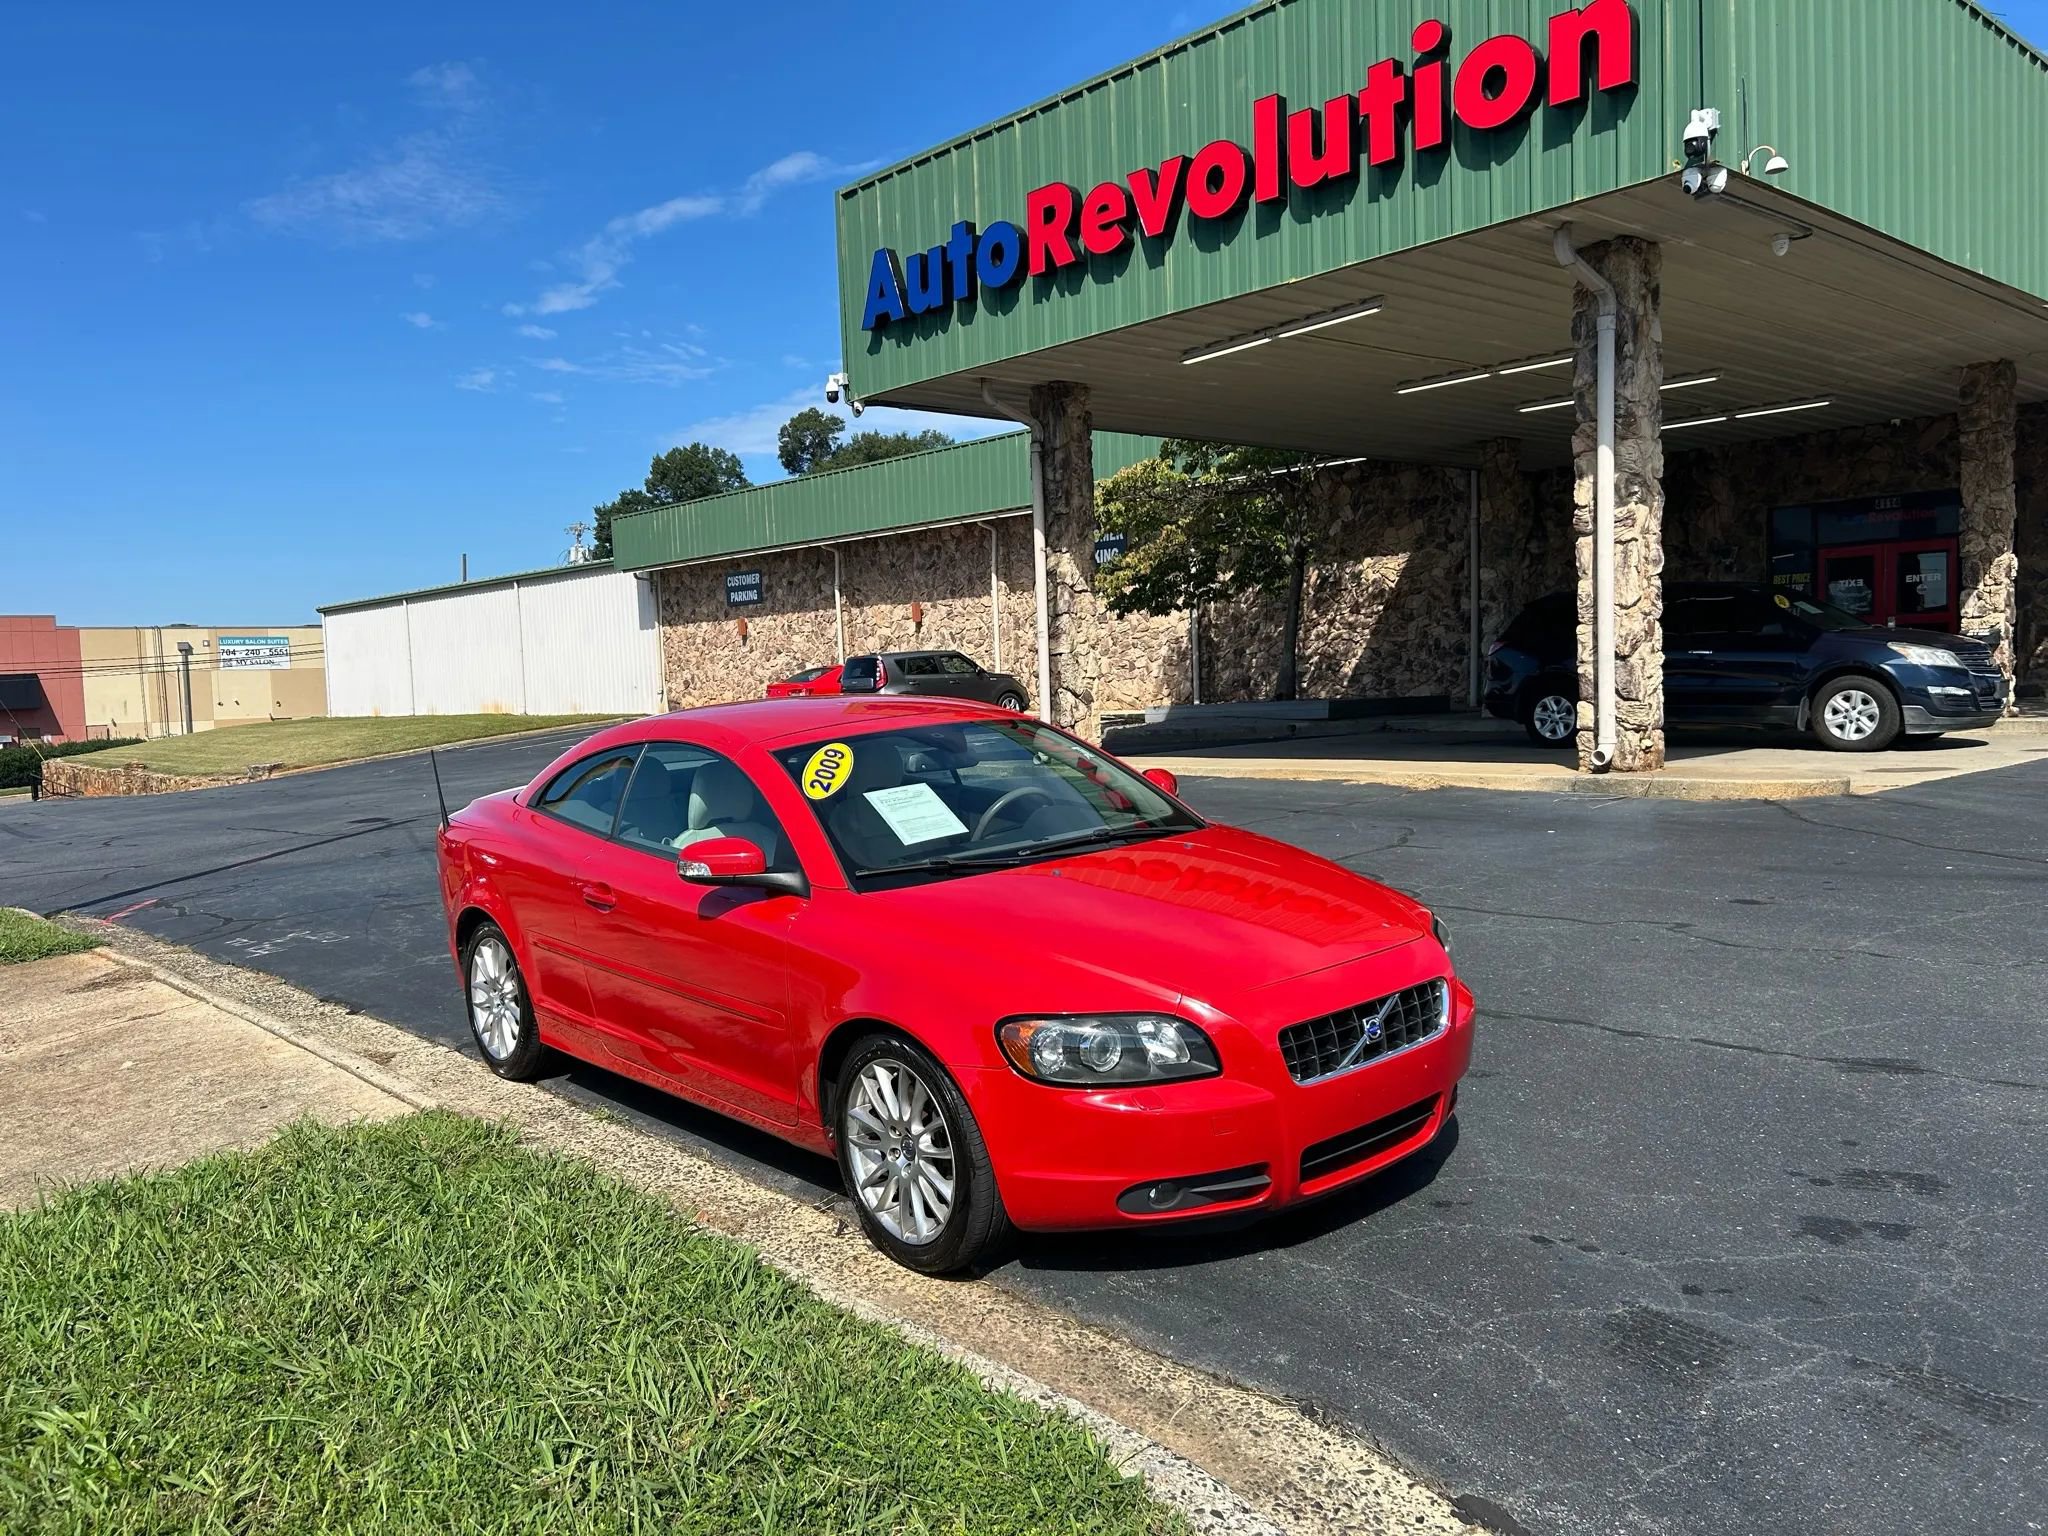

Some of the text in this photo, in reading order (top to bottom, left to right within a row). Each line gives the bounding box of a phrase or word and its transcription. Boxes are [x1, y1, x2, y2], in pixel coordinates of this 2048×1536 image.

[861, 0, 1635, 330] AutoRevolution
[727, 573, 760, 587] CUSTOMER
[1773, 573, 1811, 584] BEST PRICE
[1905, 573, 1942, 583] ENTER
[730, 589, 758, 602] PARKING
[221, 648, 237, 656] 704
[245, 648, 261, 656] 240
[809, 748, 845, 793] 2009
